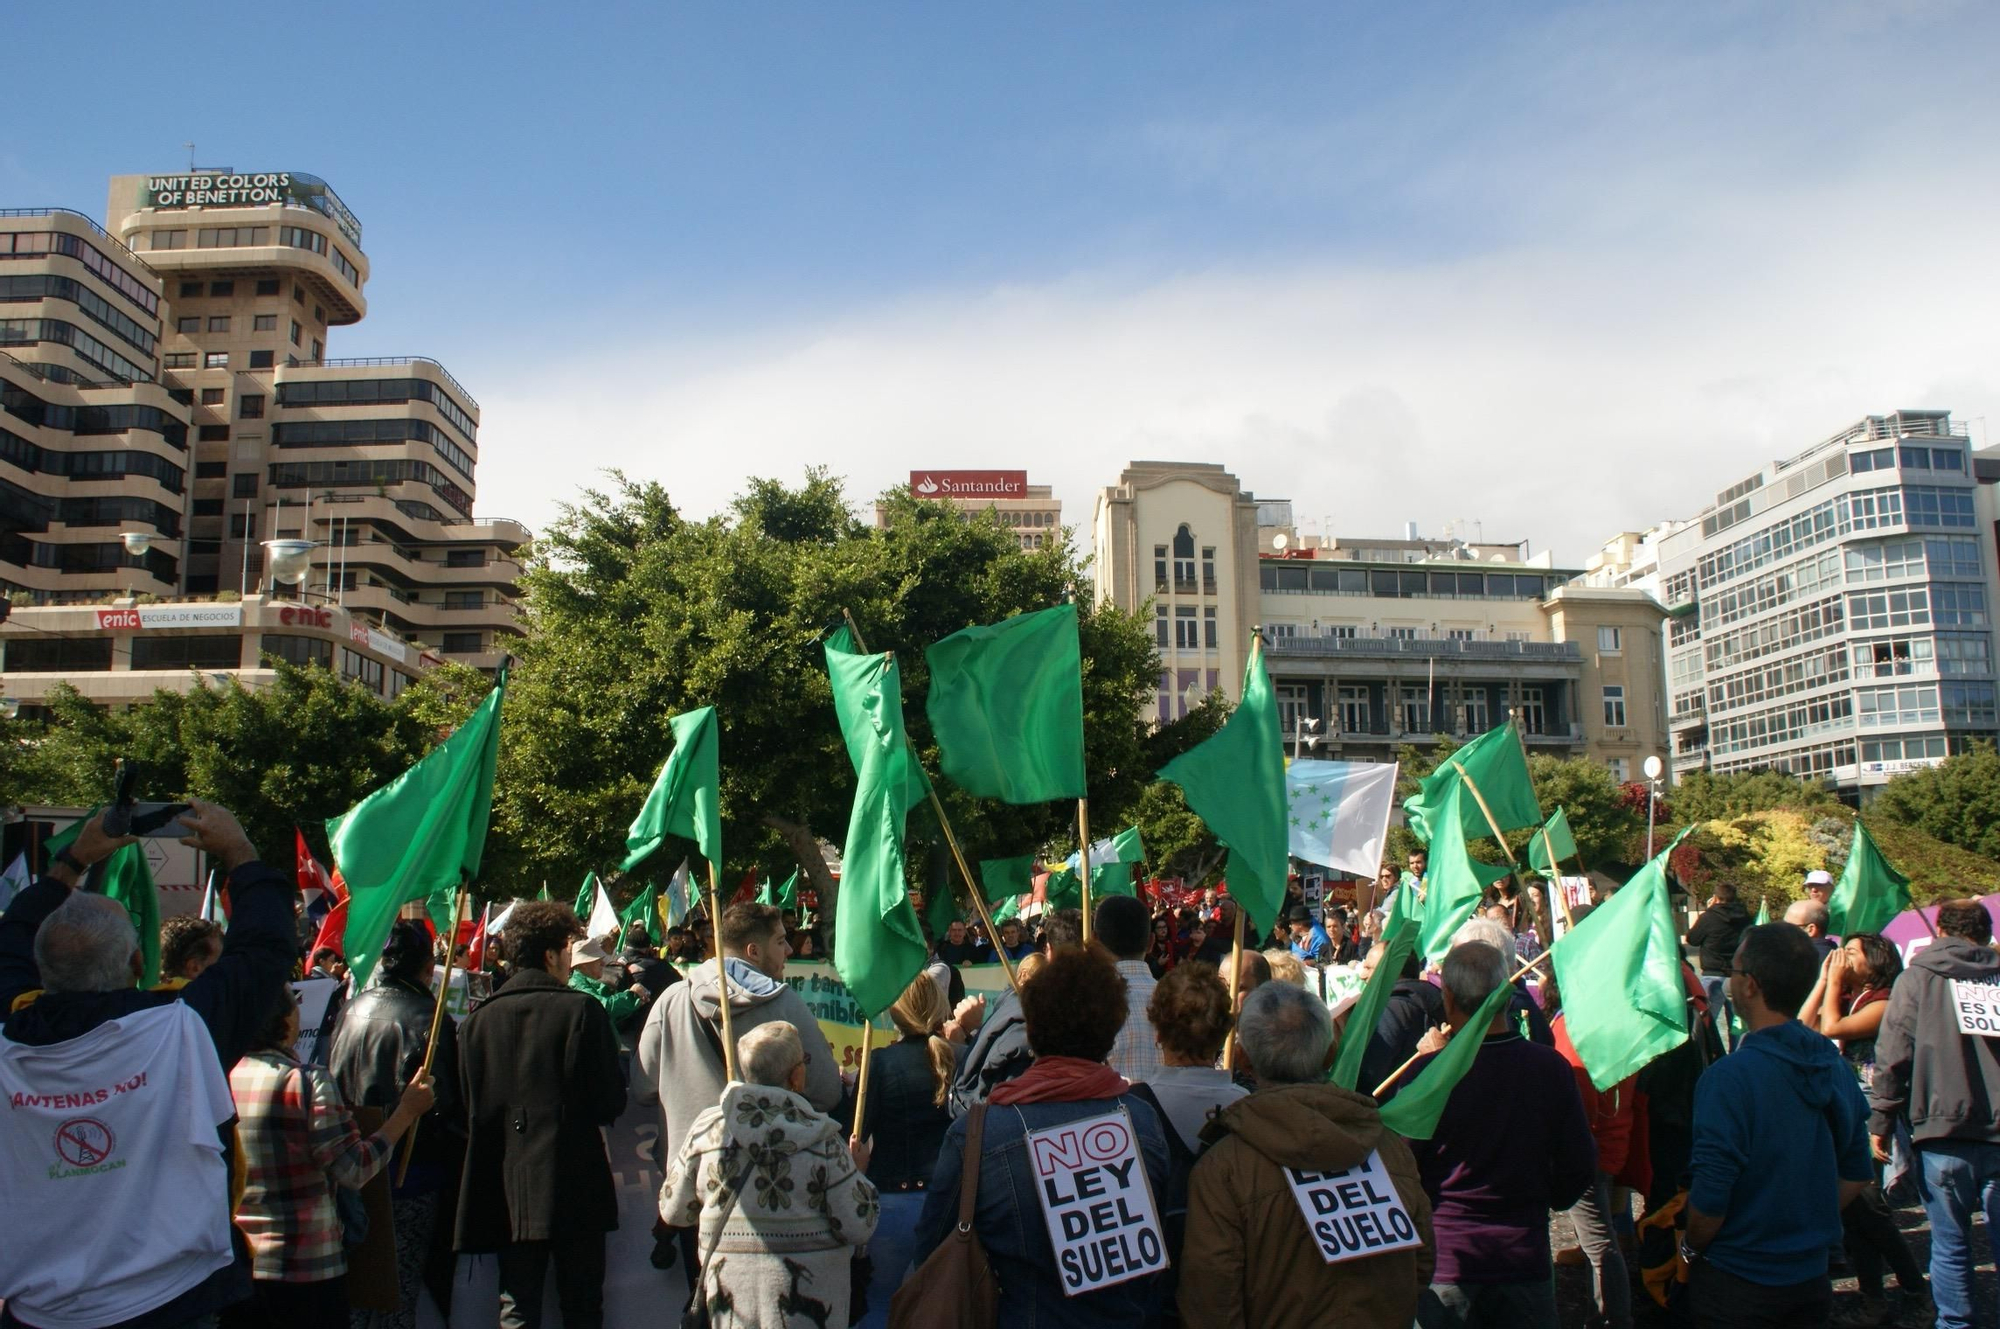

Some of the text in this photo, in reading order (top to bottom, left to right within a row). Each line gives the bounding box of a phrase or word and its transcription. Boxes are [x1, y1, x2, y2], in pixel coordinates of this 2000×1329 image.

[149, 173, 289, 191] UNITED COLORS
[158, 188, 282, 205] OF BENETTON.
[941, 477, 1021, 493] Santander
[102, 611, 235, 628] enic ESCUELA DE NEGOCIOS
[279, 606, 333, 629] enic
[1960, 1001, 1987, 1015] ES
[1034, 1122, 1129, 1176] NO
[1043, 1157, 1136, 1208] LEY
[1308, 1180, 1392, 1216] DEL
[1060, 1197, 1145, 1242] DEL
[1315, 1207, 1414, 1256] SUELO
[1061, 1227, 1161, 1288] SUELO
